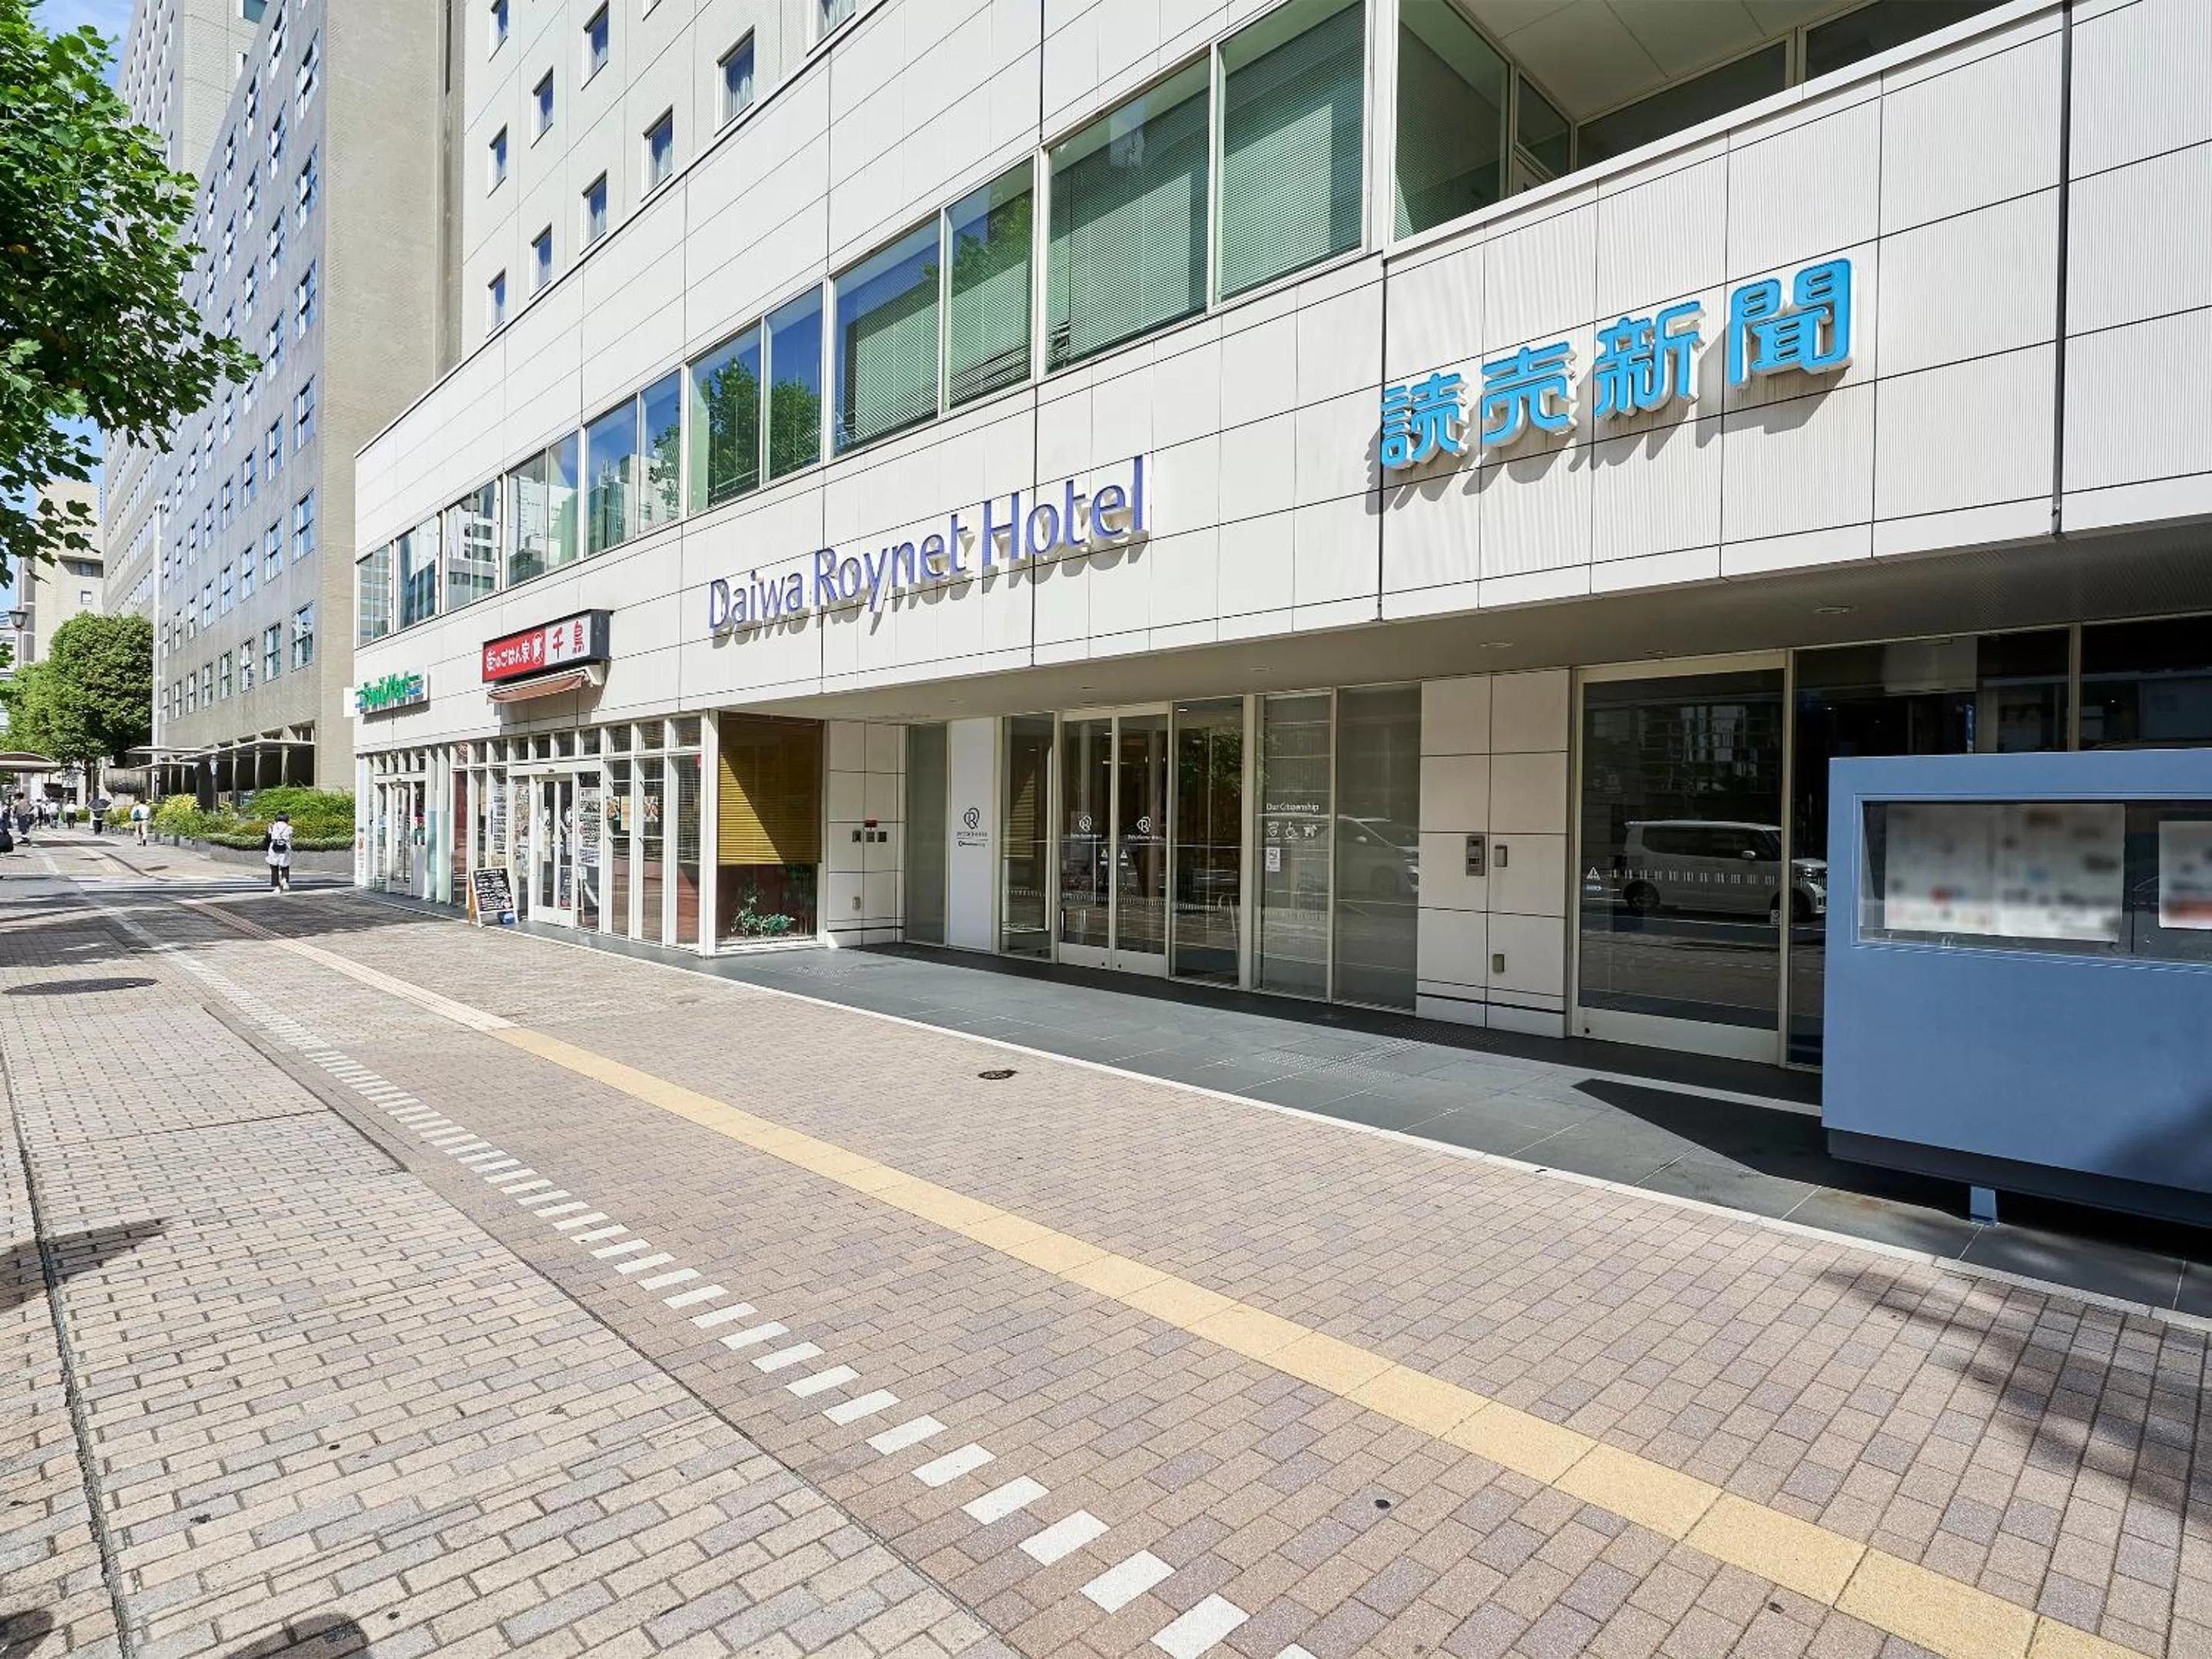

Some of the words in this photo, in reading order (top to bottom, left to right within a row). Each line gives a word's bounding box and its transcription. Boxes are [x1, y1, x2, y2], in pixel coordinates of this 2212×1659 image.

[1379, 258, 1851, 469] 読売新聞
[709, 570, 803, 630] Daiwa
[813, 513, 968, 612] Roynet
[983, 455, 1144, 567] Hotel
